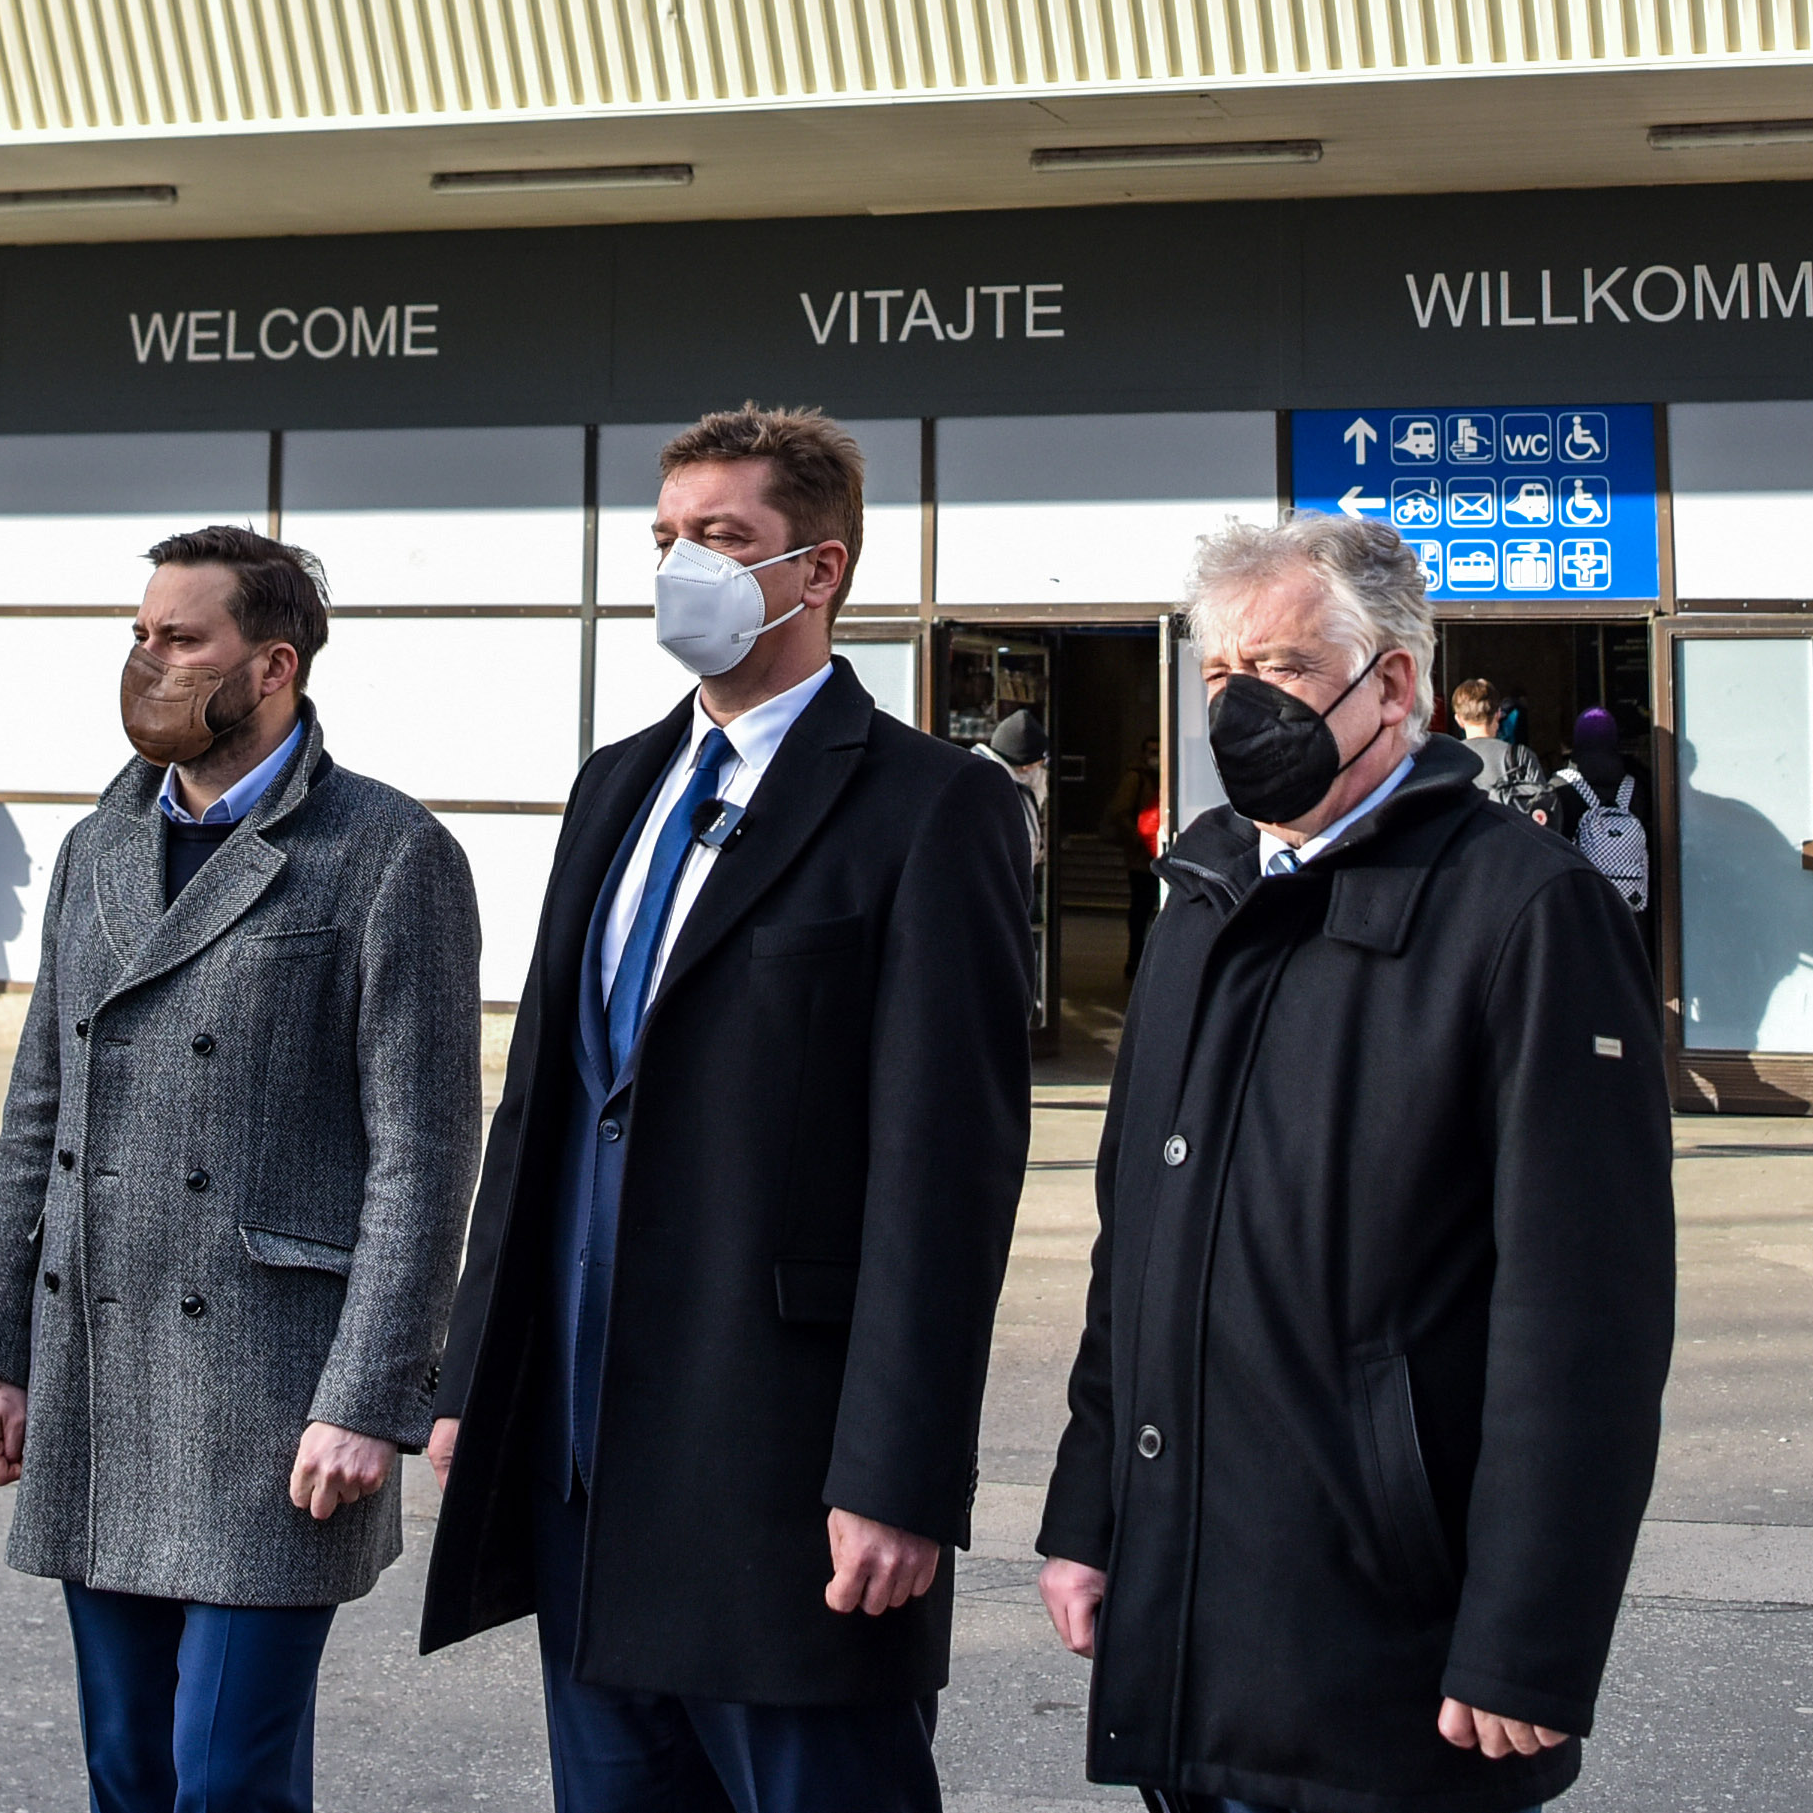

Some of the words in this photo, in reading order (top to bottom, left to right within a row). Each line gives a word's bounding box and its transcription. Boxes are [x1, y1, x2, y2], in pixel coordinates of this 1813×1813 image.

[130, 304, 439, 363] WELCOME
[800, 283, 1064, 344] VITAJTE
[1505, 434, 1549, 457] WC
